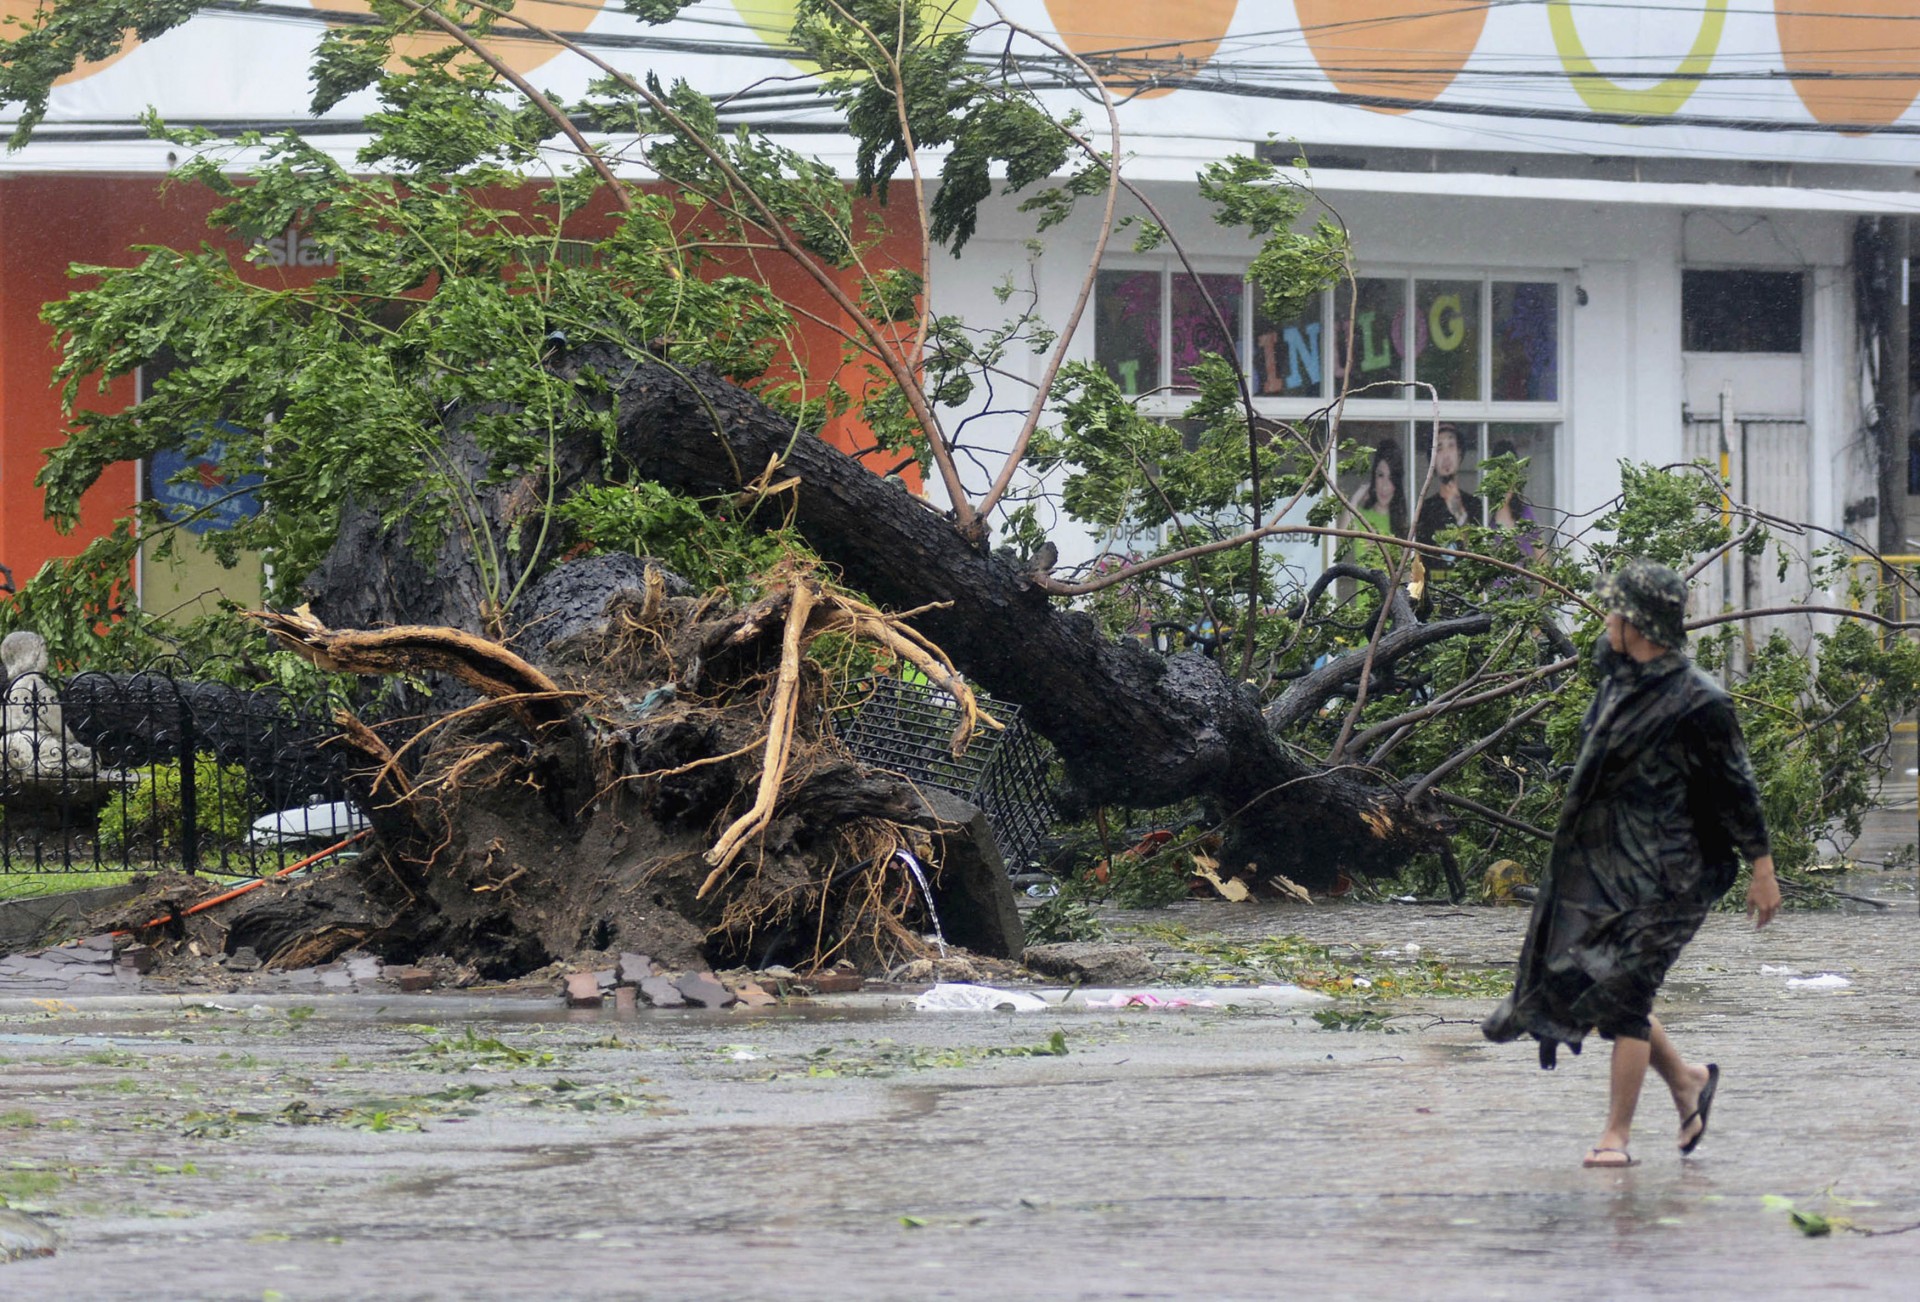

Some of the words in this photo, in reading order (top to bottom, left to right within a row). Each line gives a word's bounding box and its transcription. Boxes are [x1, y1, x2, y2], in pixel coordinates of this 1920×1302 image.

[1098, 523, 1142, 541] STORE
[1145, 524, 1157, 541] IS
[1259, 530, 1310, 543] LOSED
